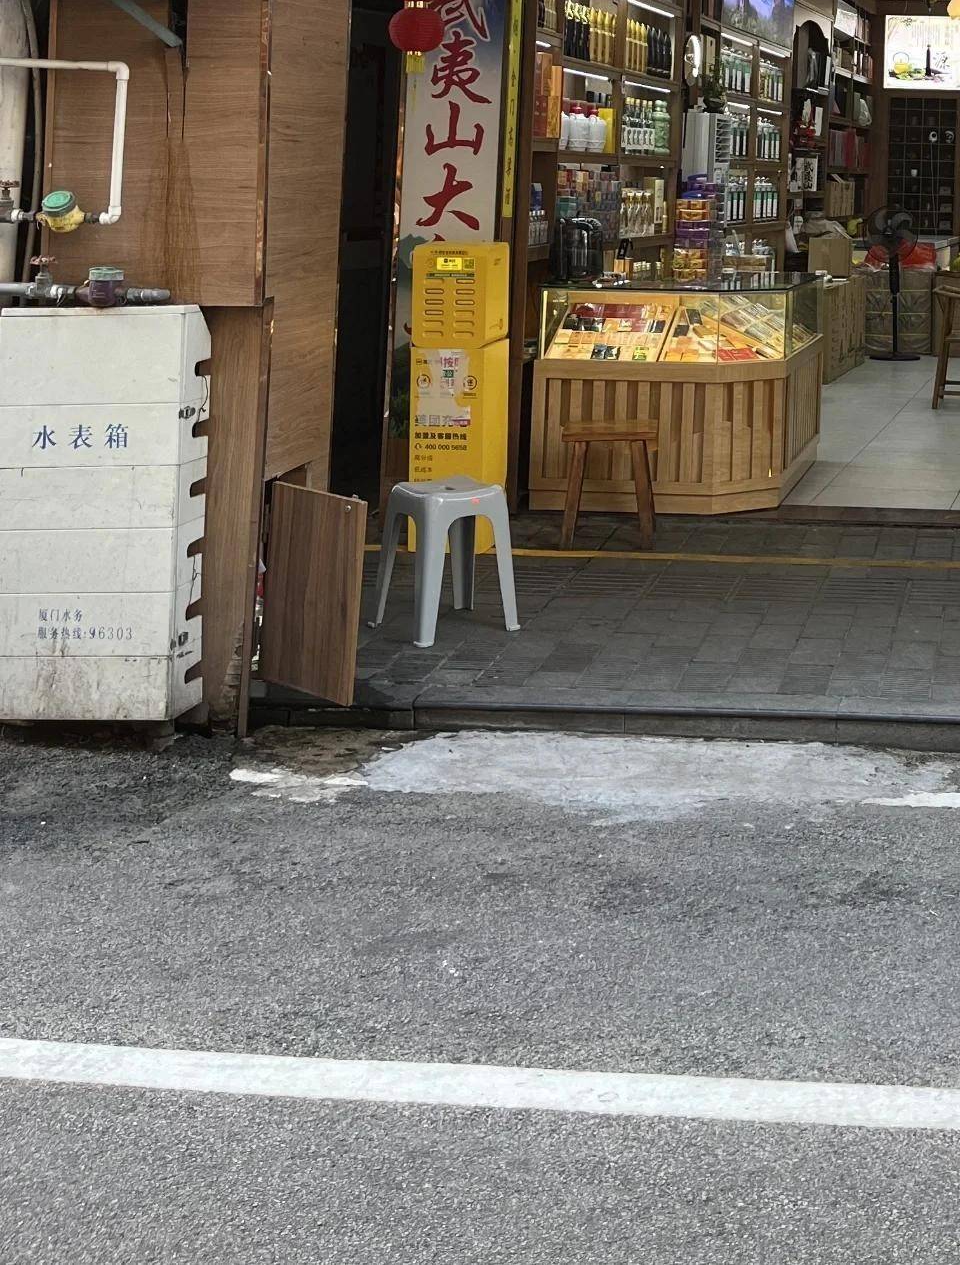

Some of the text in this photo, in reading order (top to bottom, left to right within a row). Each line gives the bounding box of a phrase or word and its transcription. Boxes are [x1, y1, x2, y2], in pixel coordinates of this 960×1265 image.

[32, 423, 129, 450] 水表箱
[38, 608, 83, 622] 厦门水务
